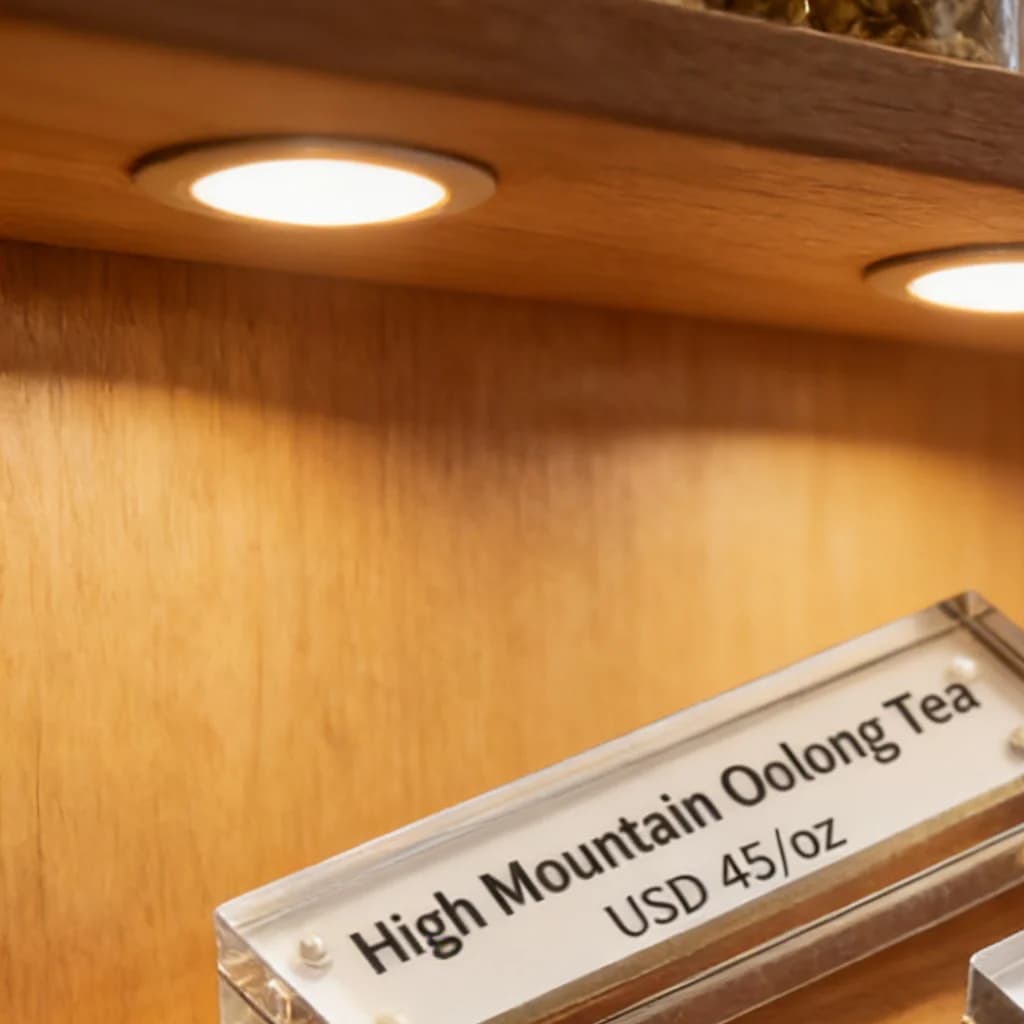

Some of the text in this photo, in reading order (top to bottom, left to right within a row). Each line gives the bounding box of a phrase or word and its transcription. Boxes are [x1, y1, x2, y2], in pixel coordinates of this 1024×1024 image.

[350, 682, 981, 976] High Mountain Oolong Tea
[603, 817, 848, 938] USD 45/oz
